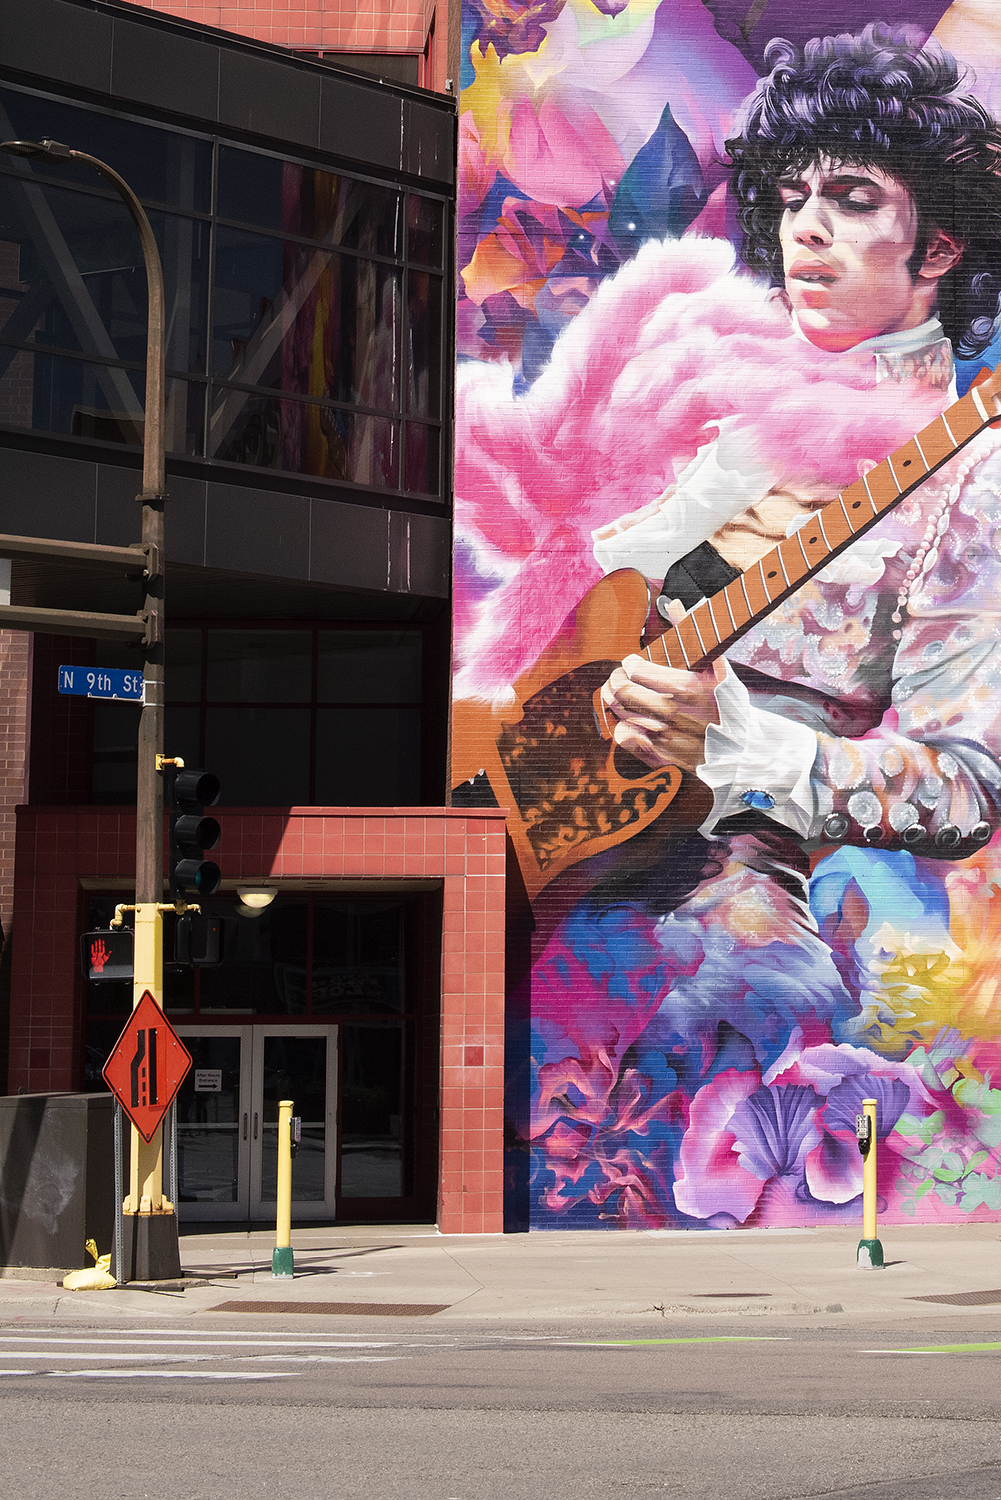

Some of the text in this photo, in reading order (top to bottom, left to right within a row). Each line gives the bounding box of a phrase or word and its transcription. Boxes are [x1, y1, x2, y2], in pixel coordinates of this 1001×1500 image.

[64, 671, 138, 692] N 9th St
